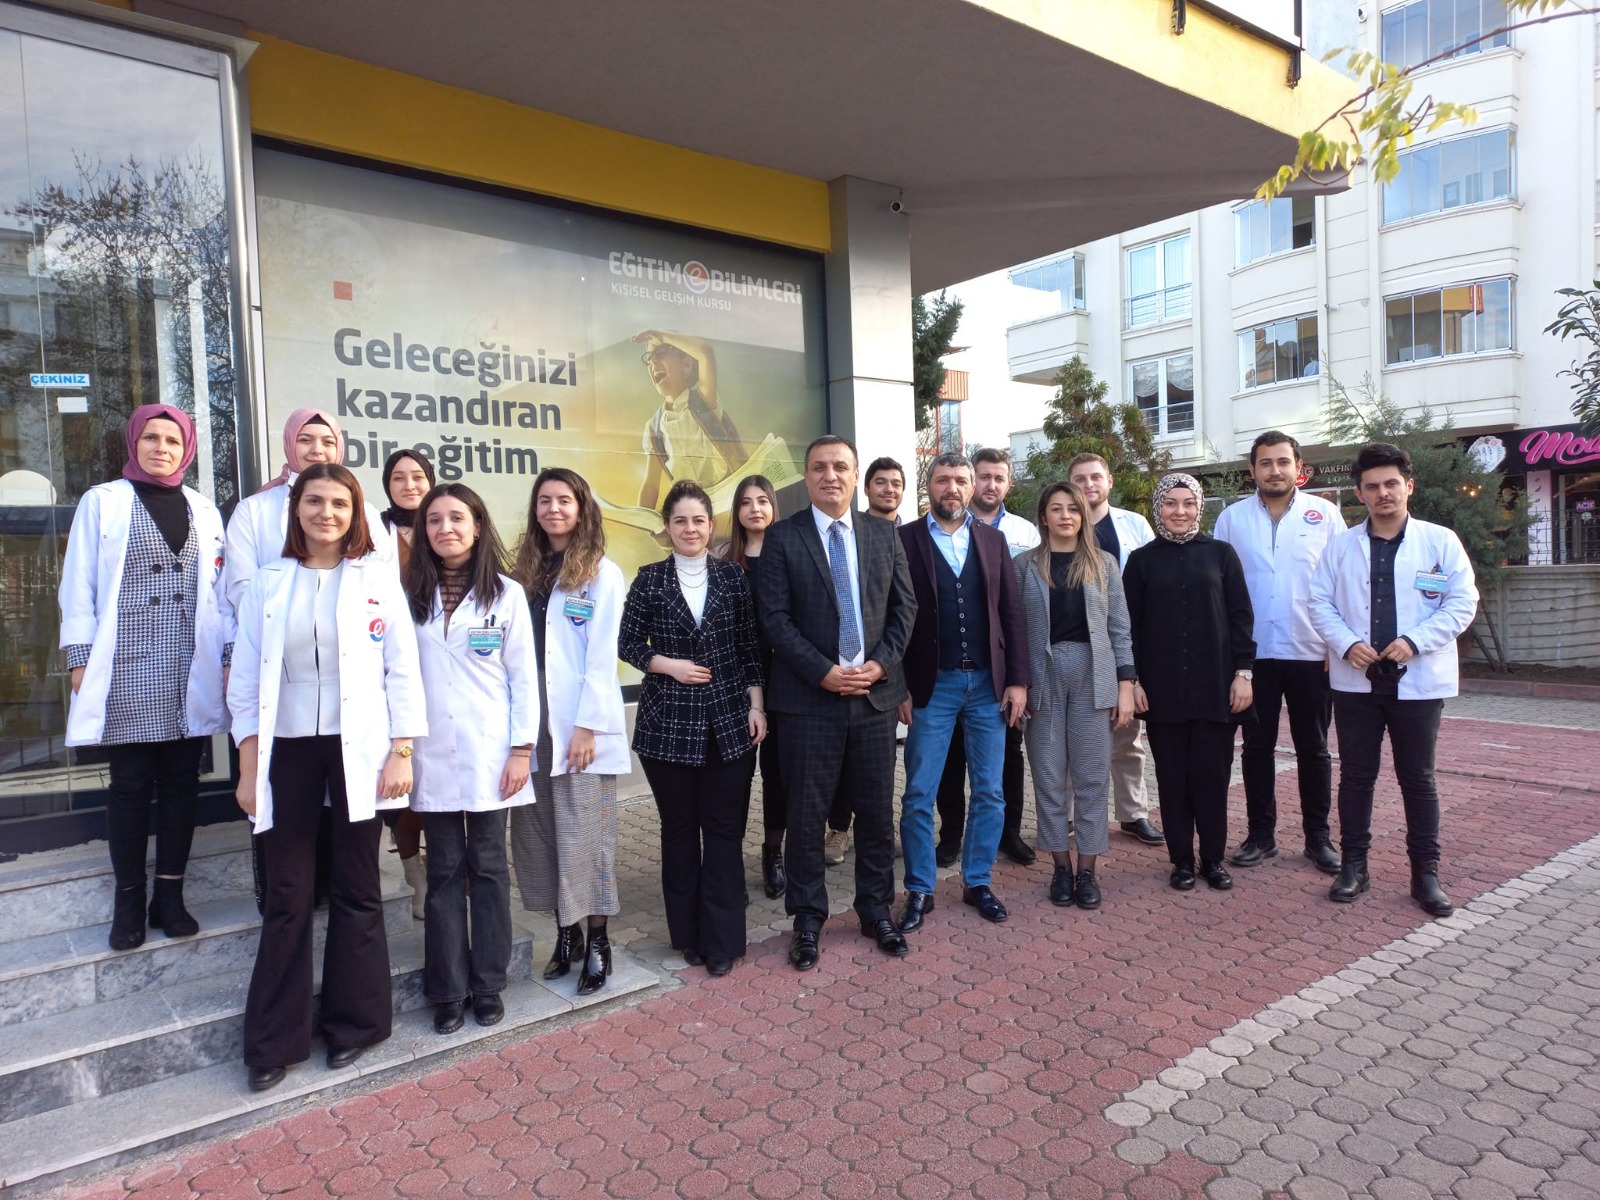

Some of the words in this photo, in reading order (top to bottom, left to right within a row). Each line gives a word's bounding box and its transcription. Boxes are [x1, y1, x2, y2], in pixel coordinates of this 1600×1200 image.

[608, 251, 682, 285] EĞİTİM
[710, 269, 803, 305] BİLİMLERİ
[611, 282, 652, 299] KİŞİSEL
[654, 289, 695, 306] GELİŞİM
[698, 298, 732, 312] KURSU
[31, 374, 86, 385] ÇEKİNİZ
[333, 328, 577, 388] Geleceğinizi
[336, 378, 562, 431] kazandıran
[343, 430, 398, 469] bir
